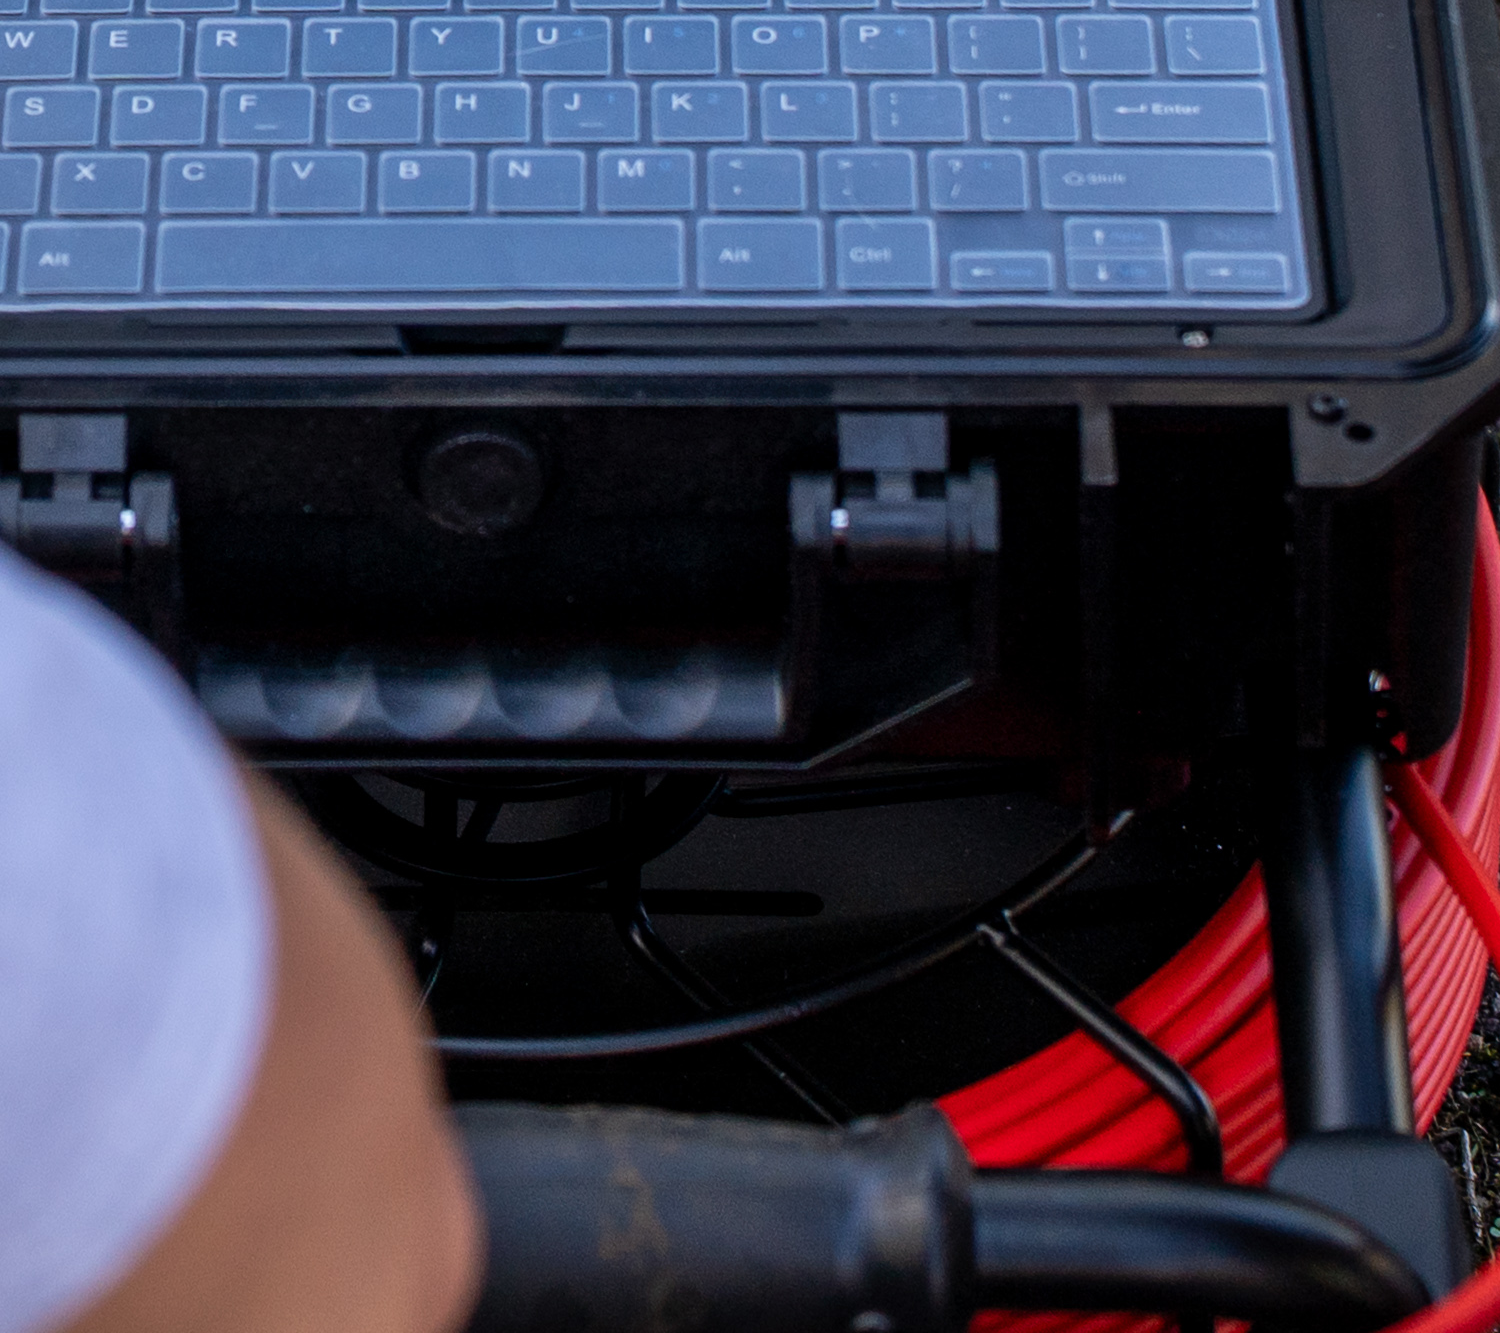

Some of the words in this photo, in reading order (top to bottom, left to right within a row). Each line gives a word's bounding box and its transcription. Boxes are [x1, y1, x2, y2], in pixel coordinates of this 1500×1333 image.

[5, 32, 34, 48] W
[110, 30, 127, 47] E
[216, 30, 237, 46] R
[325, 29, 342, 45] T
[431, 28, 451, 44] Y
[537, 28, 558, 45] U
[645, 27, 651, 43] I
[752, 27, 777, 44] O
[860, 26, 880, 42] P
[24, 98, 44, 115] S
[132, 96, 154, 113] D
[240, 95, 256, 112] F
[347, 95, 372, 112] G
[455, 94, 476, 110] H
[564, 93, 580, 110] J
[672, 94, 692, 110] K
[780, 94, 796, 110] L
[1152, 103, 1200, 114] Enter
[75, 164, 95, 180] X
[182, 162, 204, 180] C
[292, 162, 314, 179] V
[399, 161, 419, 179] B
[509, 160, 530, 177] N
[618, 159, 644, 177] M
[39, 252, 69, 266] Alt
